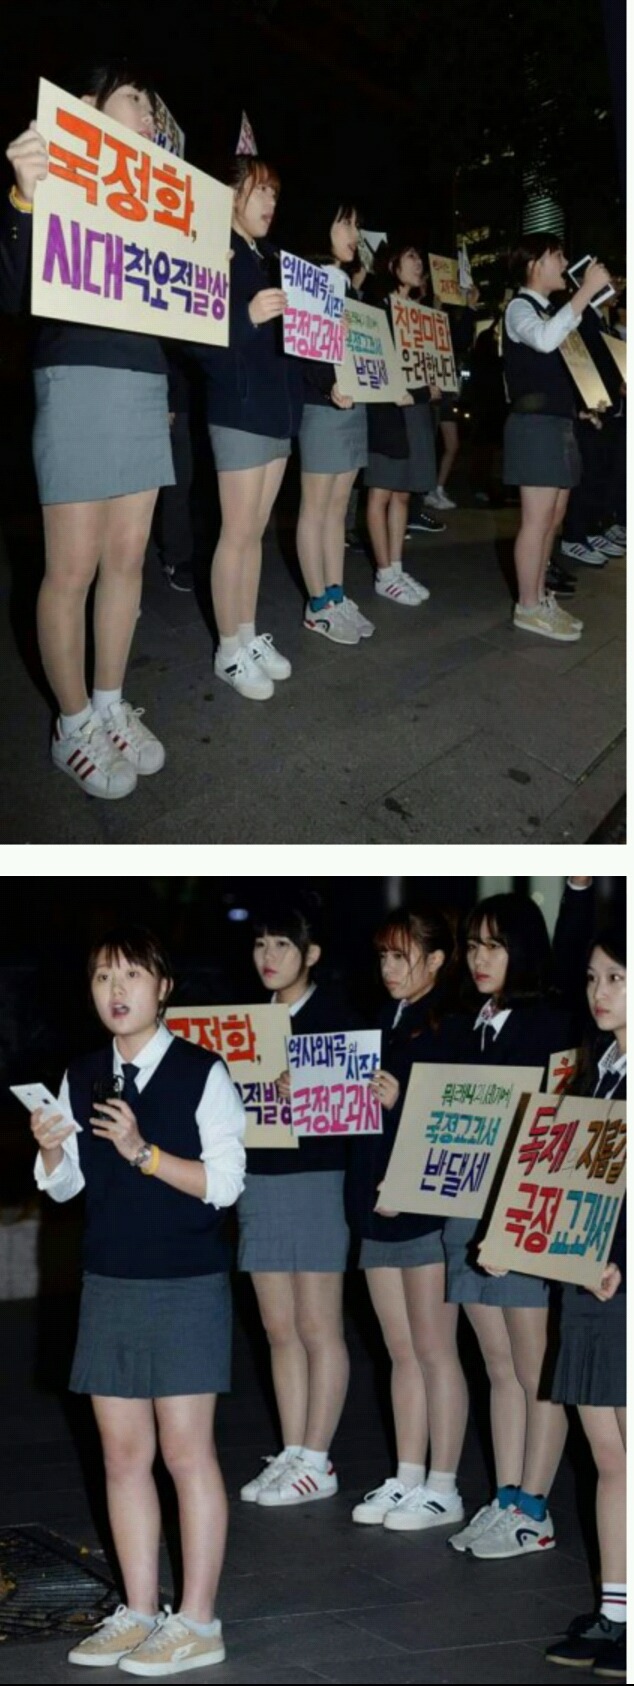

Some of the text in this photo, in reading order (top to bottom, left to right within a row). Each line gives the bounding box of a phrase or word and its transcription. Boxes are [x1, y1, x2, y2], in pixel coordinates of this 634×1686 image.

[48, 107, 197, 243] 국정화,
[284, 307, 344, 361] 국정교과서
[402, 349, 456, 387] 우려합니다
[346, 1053, 380, 1081] 시작
[293, 1083, 380, 1133] 국정교과서
[425, 1111, 502, 1146] 국정교과서
[419, 1148, 490, 1198] 반댈세
[505, 1182, 619, 1262] 국정교과서
